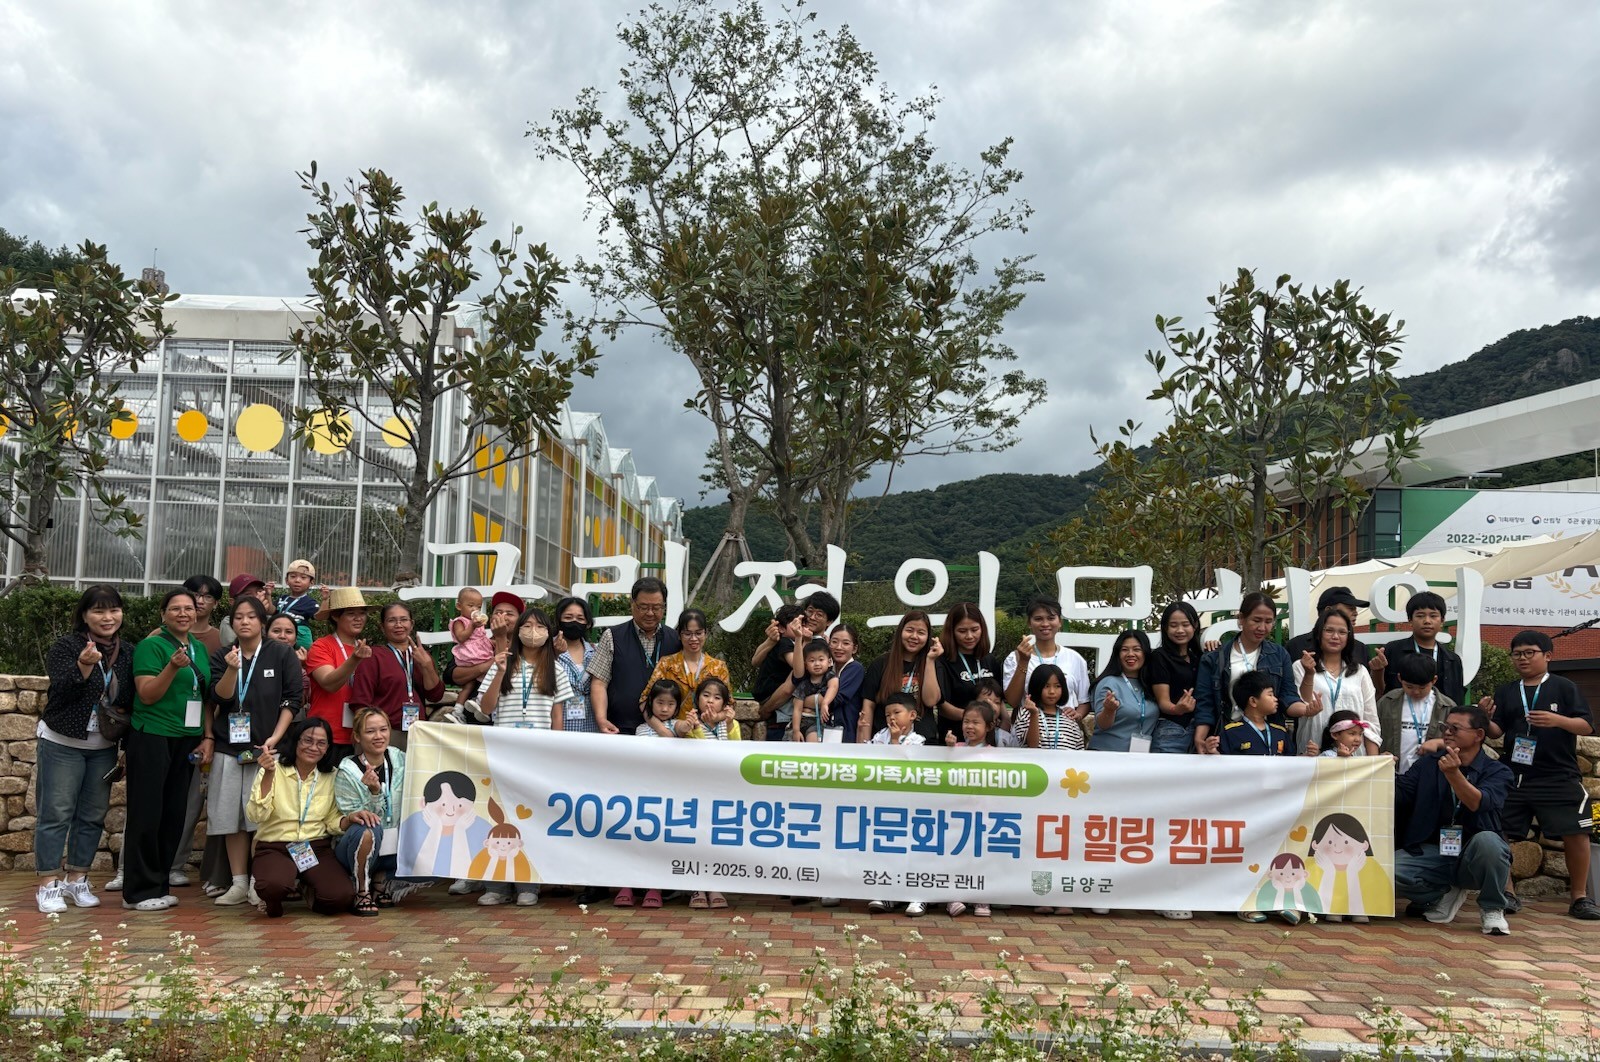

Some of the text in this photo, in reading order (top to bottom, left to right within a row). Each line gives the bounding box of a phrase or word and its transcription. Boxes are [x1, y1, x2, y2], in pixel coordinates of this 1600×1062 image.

[760, 759, 1027, 789] 다문화가정 가족사랑 해피데이
[547, 792, 1246, 865] 2025년 담양군 다문화가족 더 힐링 캠프
[671, 859, 700, 876] 일시
[712, 862, 750, 878] 2025.
[754, 865, 767, 879] 9.
[771, 866, 792, 881] 20.
[796, 866, 820, 883] (토)
[862, 870, 893, 886] 장소
[905, 872, 950, 889] 담양군
[954, 874, 985, 891] 관내
[1061, 876, 1114, 893] 담양군
